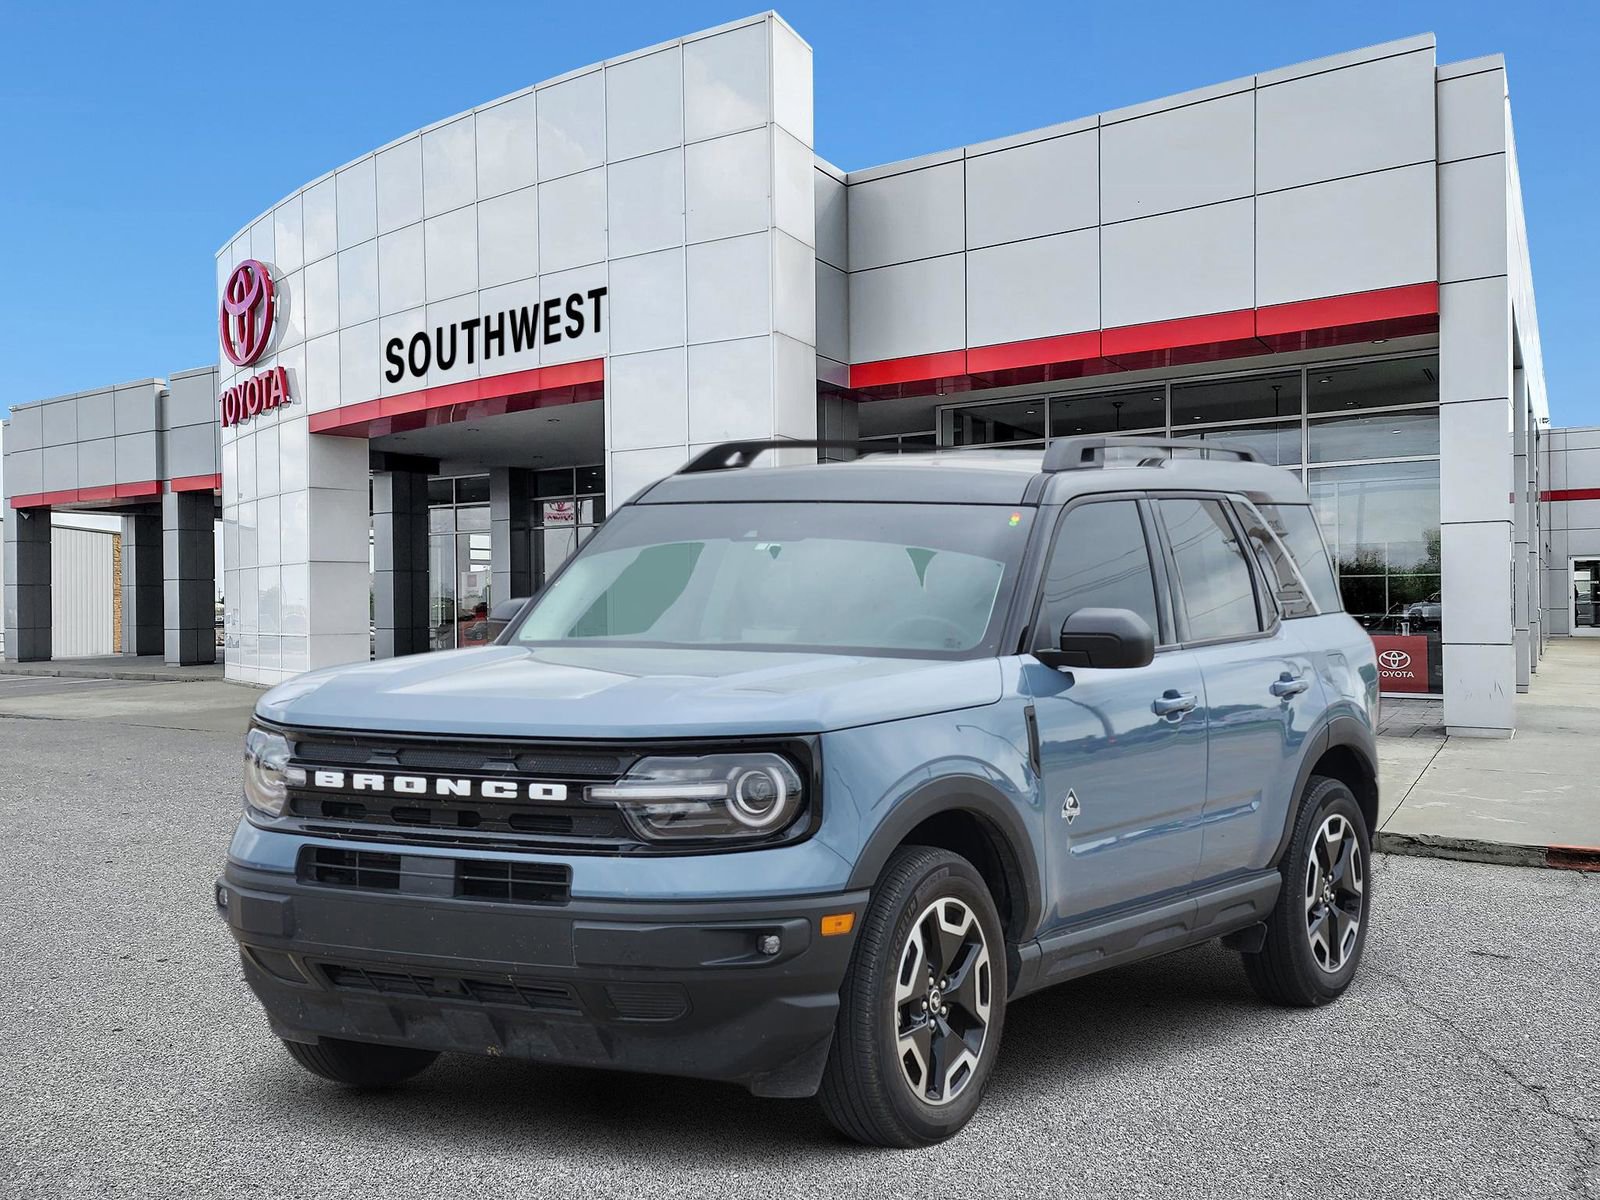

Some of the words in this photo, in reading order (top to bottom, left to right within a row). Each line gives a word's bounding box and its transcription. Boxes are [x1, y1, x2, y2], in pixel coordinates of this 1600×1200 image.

[385, 286, 608, 384] SOUTHWEST
[219, 366, 290, 428] TOYOTA
[314, 770, 568, 801] BRONCO
